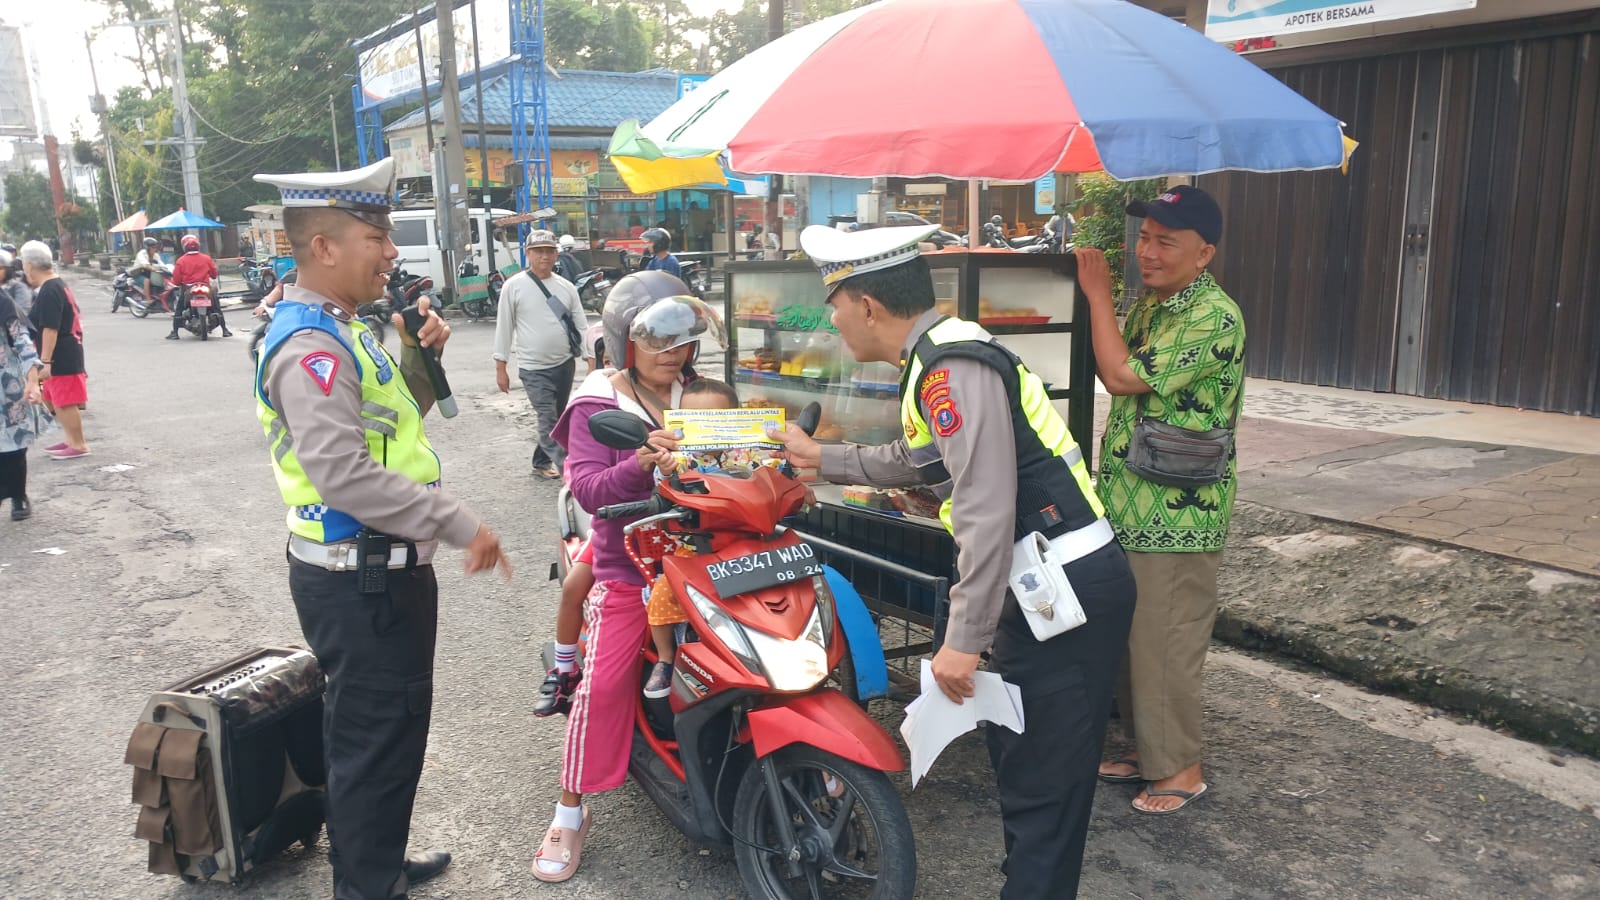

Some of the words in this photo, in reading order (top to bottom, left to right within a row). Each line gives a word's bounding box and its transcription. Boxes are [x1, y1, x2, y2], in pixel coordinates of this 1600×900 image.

[1285, 13, 1323, 27] APOTEK
[1326, 4, 1375, 21] BERSAMA
[776, 543, 814, 564] WAD
[776, 570, 796, 581] 08
[804, 564, 822, 575] 24
[680, 653, 714, 683] HONDA
